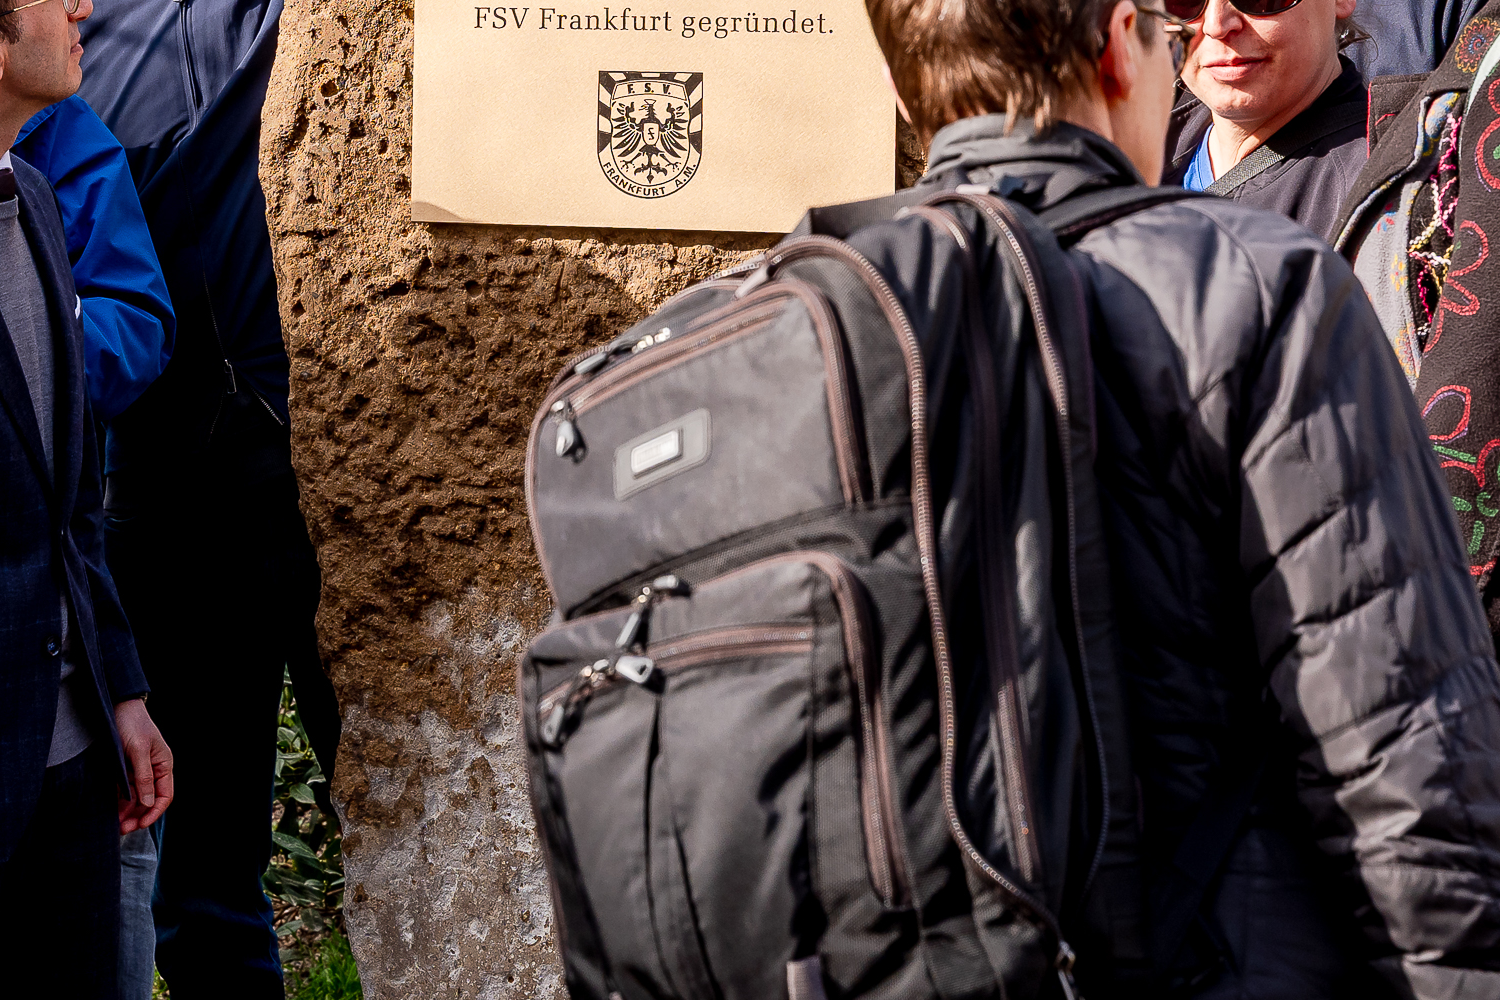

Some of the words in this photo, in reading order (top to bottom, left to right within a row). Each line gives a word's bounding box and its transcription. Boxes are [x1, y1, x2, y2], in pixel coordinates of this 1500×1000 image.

[474, 6, 530, 30] FSV
[538, 7, 673, 32] Frankfurt
[681, 9, 834, 39] gegründet.
[603, 161, 666, 197] FRANKFURT
